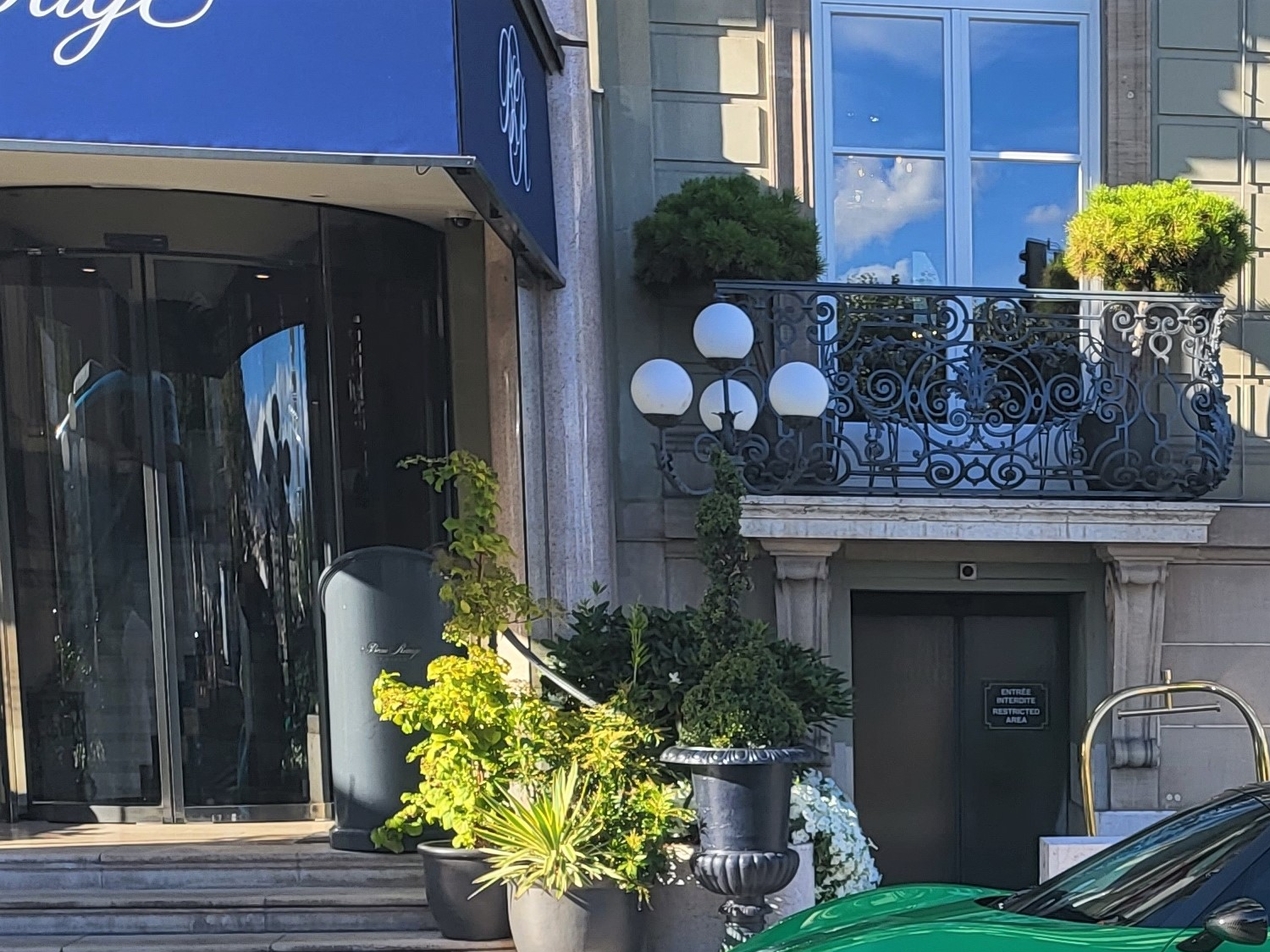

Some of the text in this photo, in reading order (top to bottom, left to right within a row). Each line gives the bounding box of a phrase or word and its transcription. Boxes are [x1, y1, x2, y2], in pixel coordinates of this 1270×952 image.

[1001, 687, 1032, 696] ENTRÉE
[996, 697, 1037, 705] INTERDITE
[992, 708, 1041, 716] RESTRICTED
[1005, 716, 1028, 724] AREA
